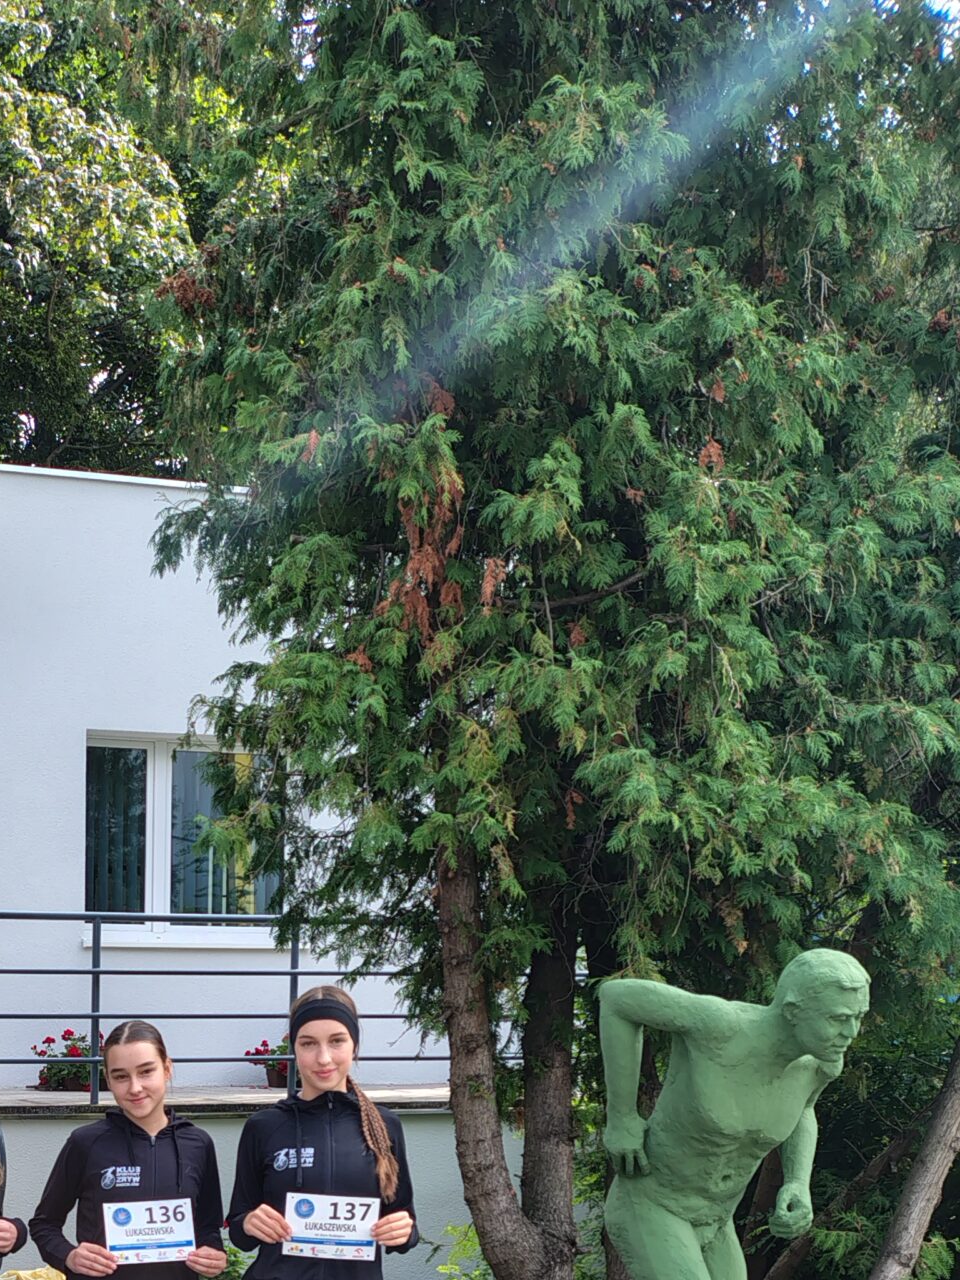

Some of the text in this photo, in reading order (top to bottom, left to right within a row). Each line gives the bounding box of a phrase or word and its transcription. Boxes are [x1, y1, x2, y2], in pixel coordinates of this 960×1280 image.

[145, 1204, 185, 1224] 136
[329, 1202, 372, 1221] 137
[125, 1226, 175, 1237] ŁUKASZEWSKA
[304, 1221, 357, 1233] ŁUKASZEWSKA
